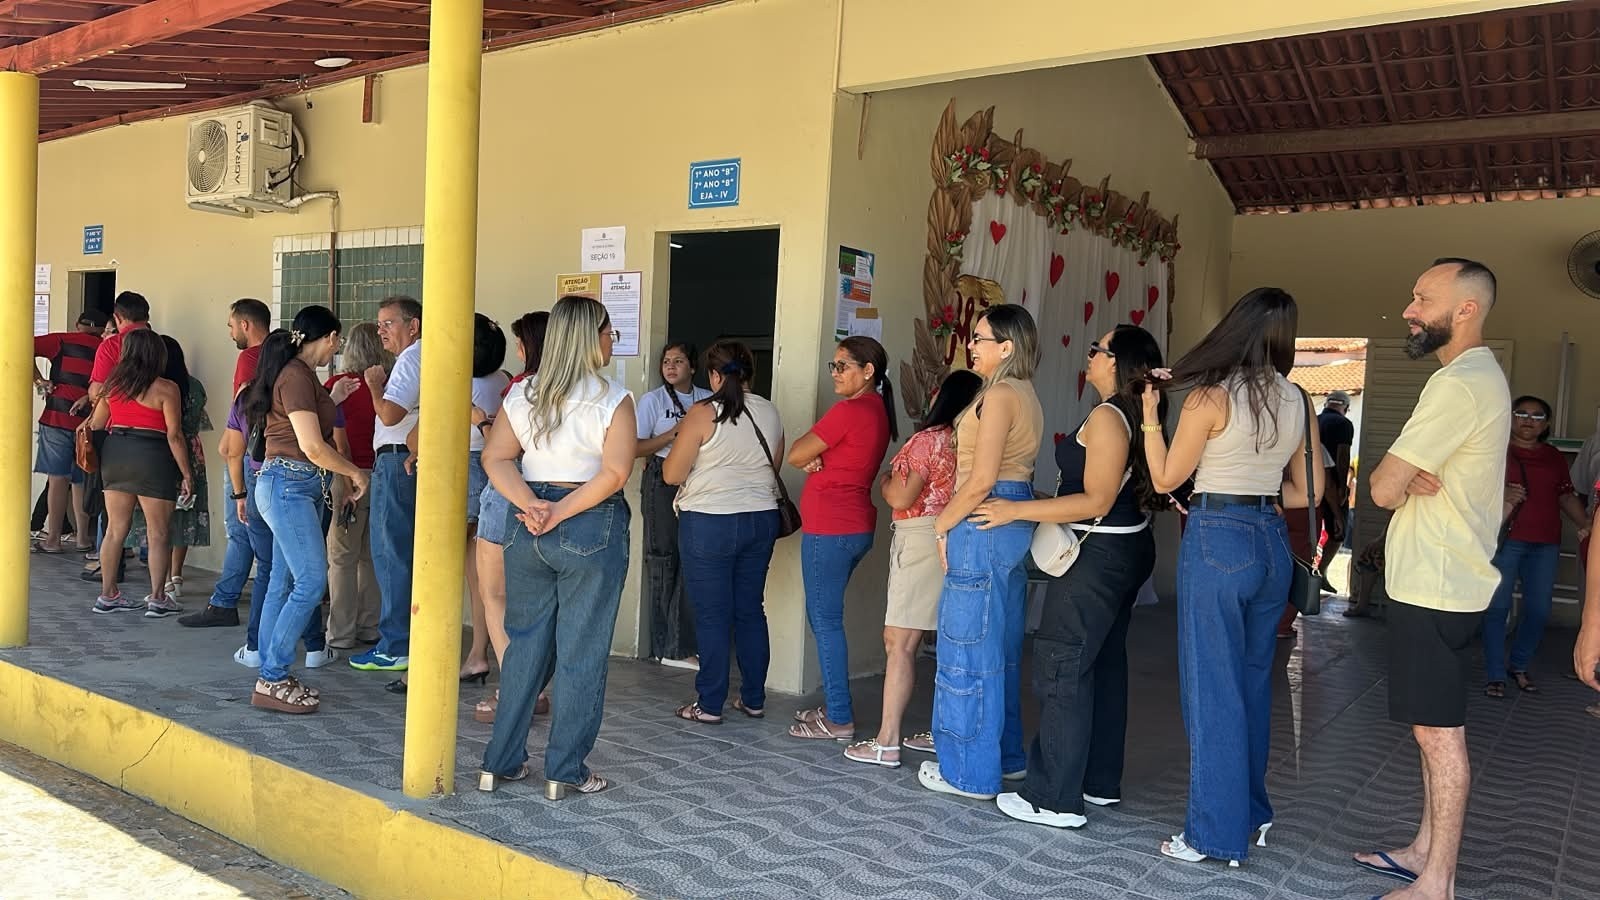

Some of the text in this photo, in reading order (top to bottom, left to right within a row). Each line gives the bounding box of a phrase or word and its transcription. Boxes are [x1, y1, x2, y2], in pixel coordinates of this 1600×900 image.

[234, 120, 243, 184] AGRATTO
[703, 169, 720, 178] ANO
[703, 180, 720, 189] ANO
[700, 192, 713, 200] EJA
[720, 190, 729, 199] IV
[590, 252, 609, 262] SEÇÃO
[564, 278, 588, 286] ATENÇÃO
